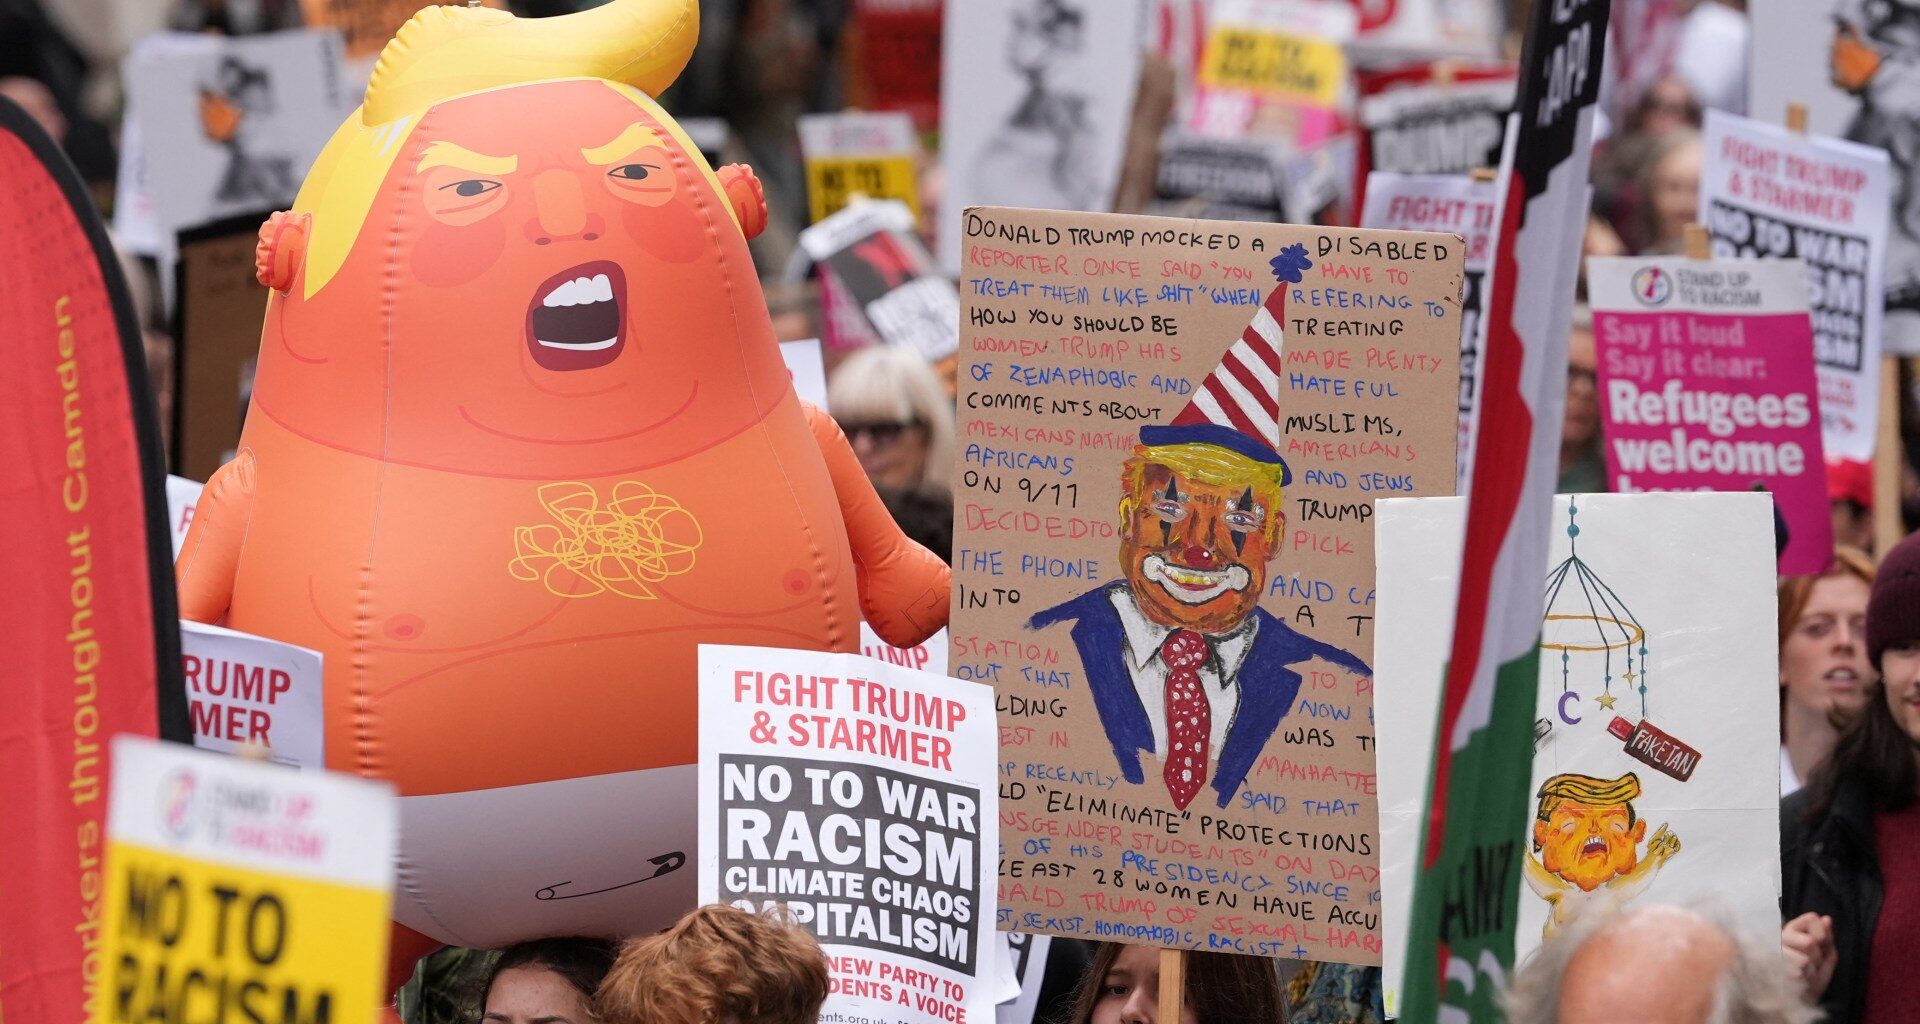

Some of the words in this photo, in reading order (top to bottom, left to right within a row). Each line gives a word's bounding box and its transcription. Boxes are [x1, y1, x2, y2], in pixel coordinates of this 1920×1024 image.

[1721, 135, 1779, 173] FIGHT
[1783, 152, 1868, 192] TRUMP
[1387, 196, 1467, 225] FIGHT
[967, 214, 1060, 246] DONALD
[1068, 228, 1135, 247] TRUMP
[1142, 230, 1240, 250] MOCKED
[1251, 237, 1264, 252] A
[1318, 235, 1447, 262] DISABLED
[1795, 227, 1868, 270] WAR
[970, 246, 1069, 275] REPORTER
[1083, 258, 1142, 279] ONCE
[1161, 260, 1202, 280] SAID
[1210, 260, 1252, 281] "YOU
[1321, 262, 1373, 284] HAVE
[1386, 268, 1409, 286] TO
[970, 278, 1034, 298] TREAT
[1040, 284, 1090, 305] THEM
[1102, 287, 1149, 308] LIKE
[1292, 288, 1413, 309] REFERING
[1424, 301, 1445, 318] TO
[970, 306, 1017, 328] HOW
[1029, 308, 1064, 326] YOU
[1073, 315, 1145, 333] SHOULD
[1151, 315, 1178, 336] BE
[1291, 318, 1404, 337] TREATING
[1602, 317, 1653, 351] Say
[1659, 316, 1683, 345] it
[1689, 317, 1746, 347] loud
[1059, 335, 1130, 363] TRUMP
[1138, 343, 1182, 362] HAS
[1286, 351, 1352, 370] MADE
[1366, 347, 1442, 374] PLENTY
[1605, 349, 1655, 383] Say
[1662, 348, 1687, 376] it
[1691, 350, 1768, 379] clear:
[970, 362, 993, 382] OF
[1009, 364, 1138, 389] ZENAPHOBIC
[1151, 374, 1192, 395] AND
[55, 296, 89, 512] Camden
[967, 391, 1093, 417] COMMENTS
[1099, 402, 1162, 421] ABOUT
[1607, 378, 1812, 437] Refugees
[967, 419, 1074, 446] MEXICANS
[1080, 432, 1136, 450] NATIVE
[1287, 438, 1416, 462] AMERICANS
[1612, 427, 1806, 476] welcome
[965, 443, 1075, 476] AFRICANS
[1304, 469, 1347, 489] AND
[1358, 472, 1414, 492] JEWS
[964, 470, 1001, 494] ON
[1018, 478, 1078, 508] 9/11
[1297, 498, 1373, 523] TRUMP
[1293, 529, 1354, 555] PICK
[960, 550, 1004, 576] THE
[1021, 554, 1100, 580] PHONE
[1269, 575, 1334, 602] AND
[960, 584, 1020, 609] INTO
[1296, 605, 1314, 628] A
[65, 524, 101, 807] throughout
[953, 635, 1060, 666] STATION
[183, 655, 291, 705] RUMP
[957, 663, 1002, 683] OUT
[1020, 666, 1071, 690] THAT
[1310, 671, 1336, 690] TO
[189, 699, 273, 748] MER
[734, 670, 839, 710] FIGHT
[846, 678, 966, 733] TRUMP
[1299, 700, 1351, 721] NOW
[749, 711, 777, 745] &
[787, 714, 953, 772] STARMER
[1049, 731, 1069, 749] IN
[1285, 727, 1335, 748] WAS
[723, 763, 792, 802] NO
[804, 767, 864, 808] TO
[876, 775, 976, 834] WAR
[1025, 763, 1119, 791] RECENTLY
[999, 782, 1026, 800] LD
[1036, 784, 1190, 834] "ELIMINATE"
[1241, 791, 1287, 815] SAID
[1302, 798, 1360, 816] THAT
[726, 808, 973, 891] RACISM
[1131, 832, 1268, 867] STUDENTS"
[1274, 855, 1313, 875] ON
[1200, 815, 1372, 855] PROTECTIONS
[1024, 838, 1052, 856] OF
[1070, 845, 1104, 858] HIS
[1121, 849, 1271, 893] PRESIDENCY
[1286, 875, 1349, 902] SINCE
[121, 862, 188, 948] NO
[211, 882, 288, 968] TO
[725, 866, 864, 900] CLIMATE
[871, 876, 971, 924] CHAOS
[998, 859, 1076, 878] LEAST
[1092, 869, 1124, 888] 28
[1136, 878, 1237, 909] WOMEN
[1253, 896, 1315, 921] HAVE
[1328, 905, 1378, 931] ACCU
[1080, 892, 1157, 922] TRUMP
[1167, 906, 1199, 925] OF
[1211, 916, 1320, 944] SEXUAL
[1208, 933, 1284, 956] RACIST
[827, 956, 873, 977] NEW
[879, 962, 938, 994] PARTY
[943, 979, 964, 1003] TO
[898, 988, 910, 1007] A
[915, 992, 967, 1024] VOICE
